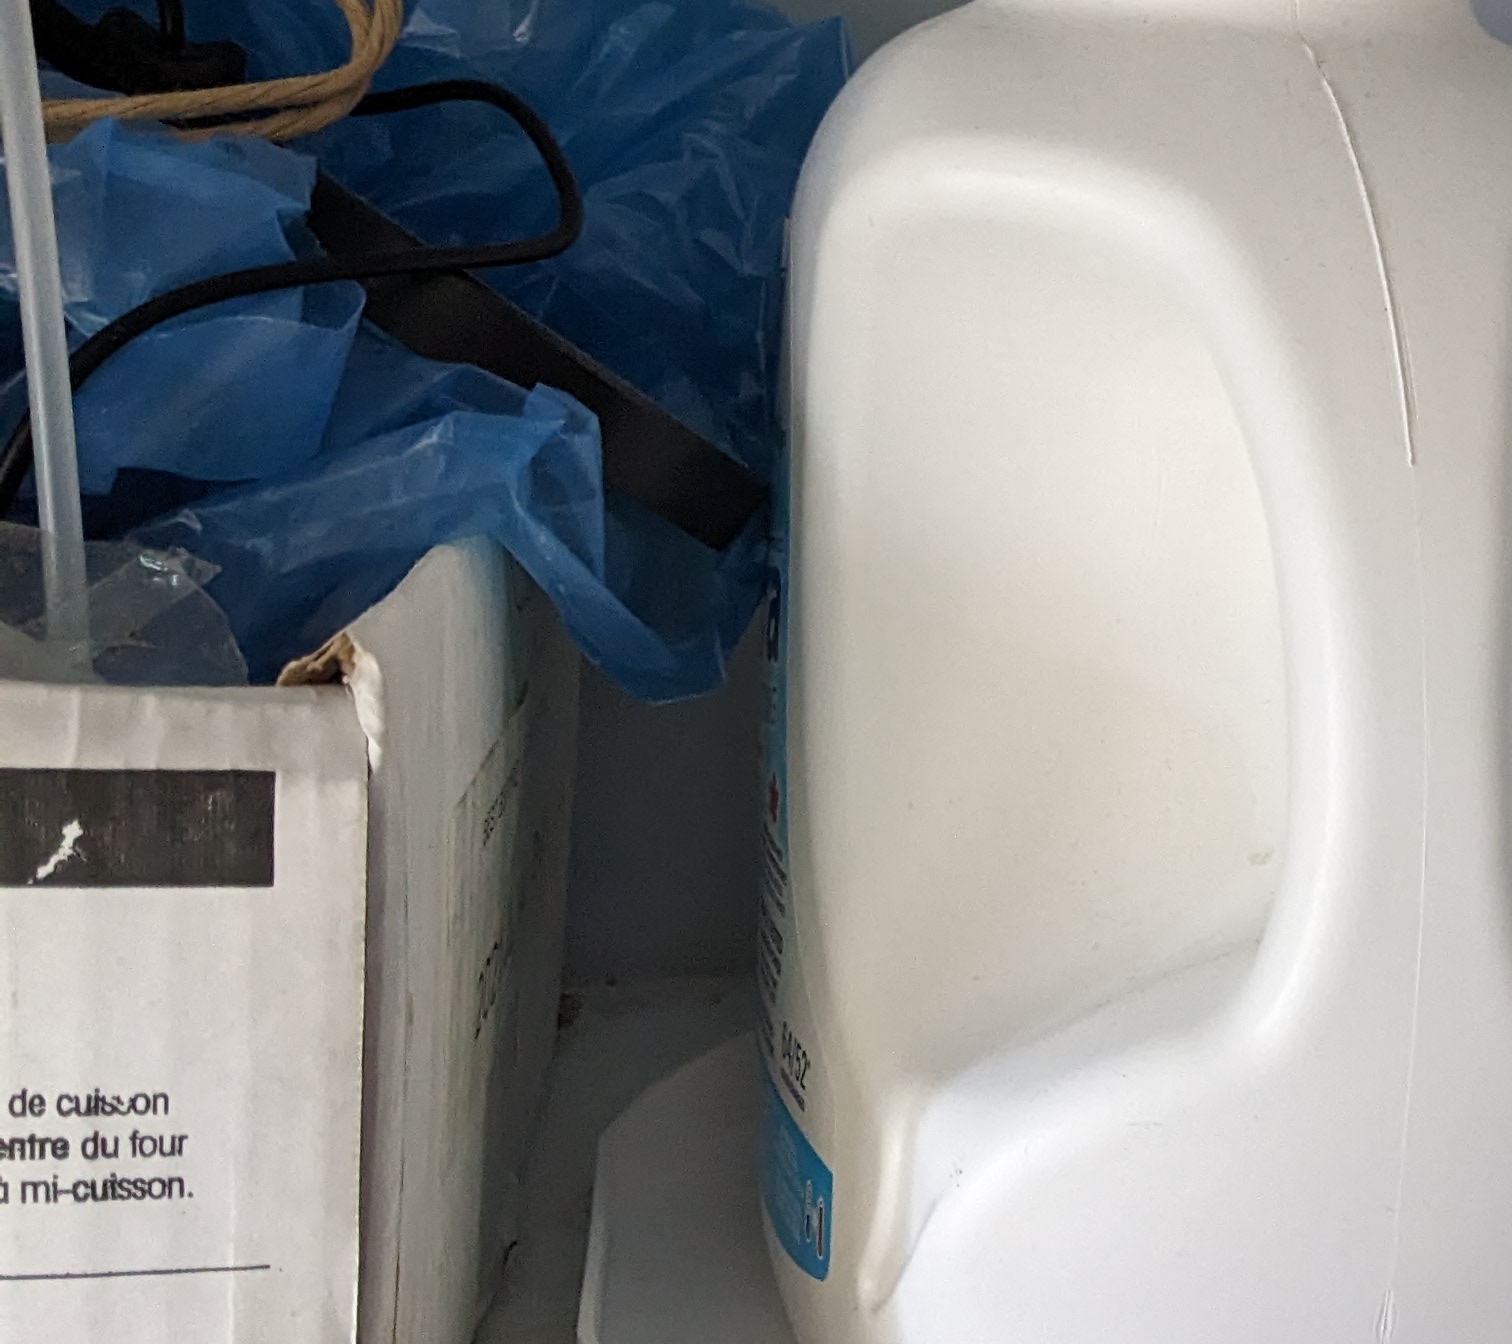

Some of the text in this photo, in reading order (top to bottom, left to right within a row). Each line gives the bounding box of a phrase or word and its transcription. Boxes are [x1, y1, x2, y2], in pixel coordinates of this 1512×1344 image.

[8, 1087, 170, 1118] de cuisson
[80, 1130, 120, 1161] du
[128, 1128, 190, 1159] four
[20, 1172, 195, 1205] mi-cuisson.
